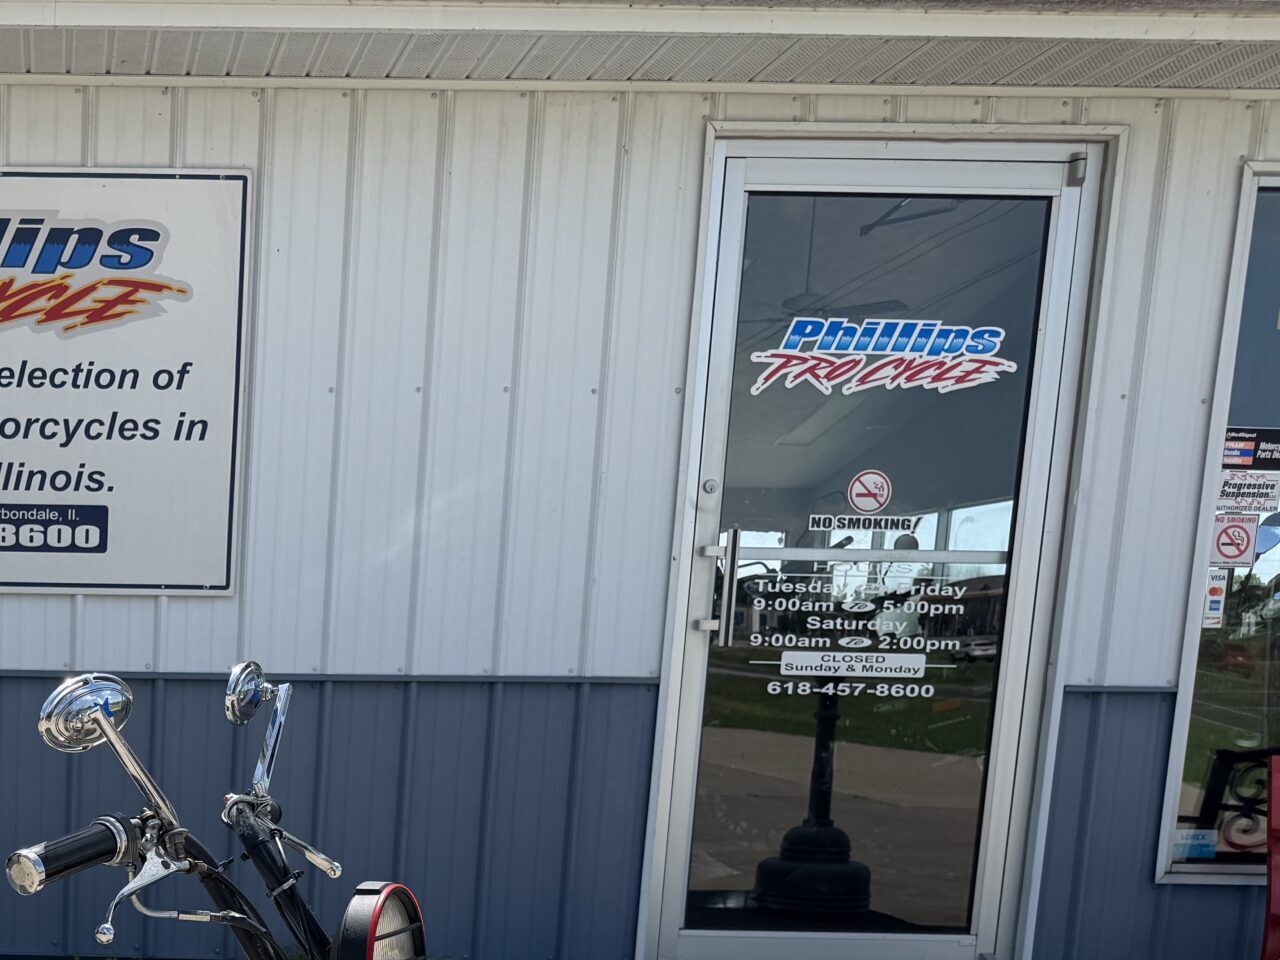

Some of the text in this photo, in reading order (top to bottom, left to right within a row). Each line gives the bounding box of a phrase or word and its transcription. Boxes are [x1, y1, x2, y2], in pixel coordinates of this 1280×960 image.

[781, 319, 1003, 356] Phillips
[153, 362, 194, 391] of
[754, 353, 1015, 392] PRO CYCLE
[174, 413, 209, 442] in
[1220, 489, 1270, 499] Suspension
[1222, 481, 1276, 491] Progressive
[810, 516, 833, 529] NO
[1226, 516, 1257, 524] SMOKING
[1210, 574, 1226, 582] VISA
[896, 582, 968, 600] Friday
[753, 597, 834, 612] 9:00am
[882, 600, 965, 617] 5:00pm
[806, 615, 908, 633] Saturday
[750, 633, 831, 648] 9:00am
[878, 635, 961, 653] 2:00pm
[821, 654, 886, 664] CLOSED
[784, 663, 921, 675] Sunday & Monday
[767, 681, 935, 698] 618-457-8600
